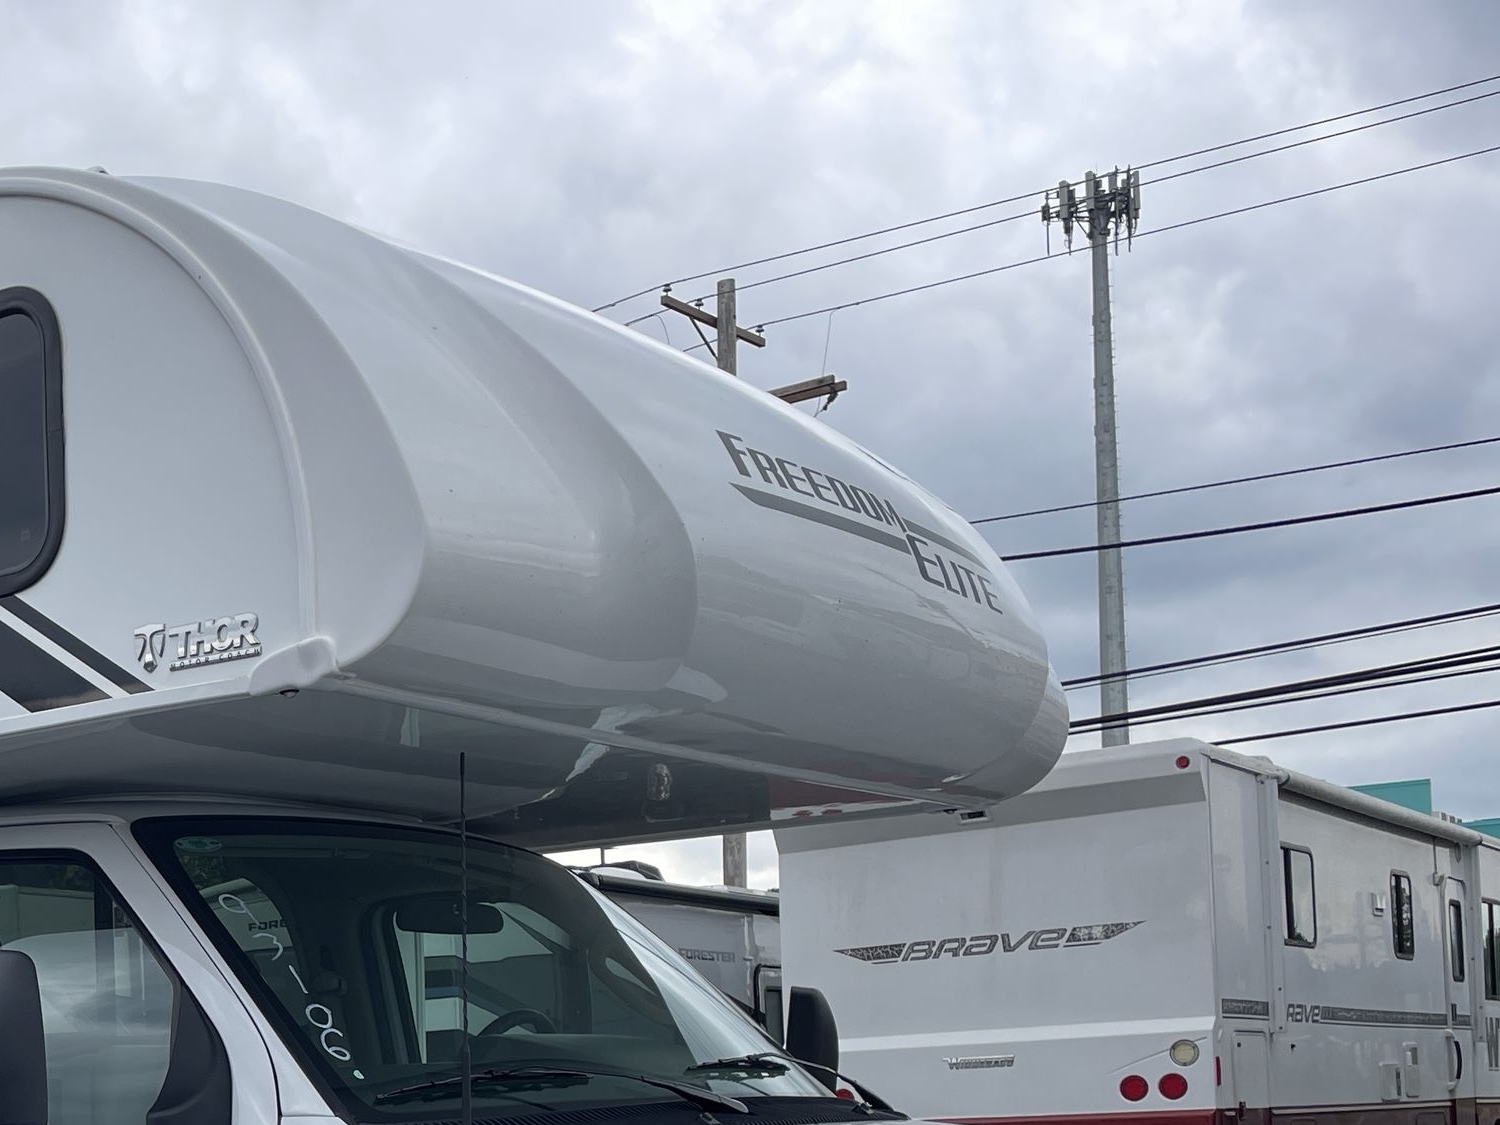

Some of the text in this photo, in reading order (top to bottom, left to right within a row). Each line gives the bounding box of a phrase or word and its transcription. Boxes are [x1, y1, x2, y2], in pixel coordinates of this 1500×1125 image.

[715, 429, 907, 533] FREEDOM
[906, 533, 1004, 615] ELITE
[169, 612, 261, 660] THOR
[170, 648, 261, 669] MOTOR COACH
[678, 947, 736, 963] FORESTER
